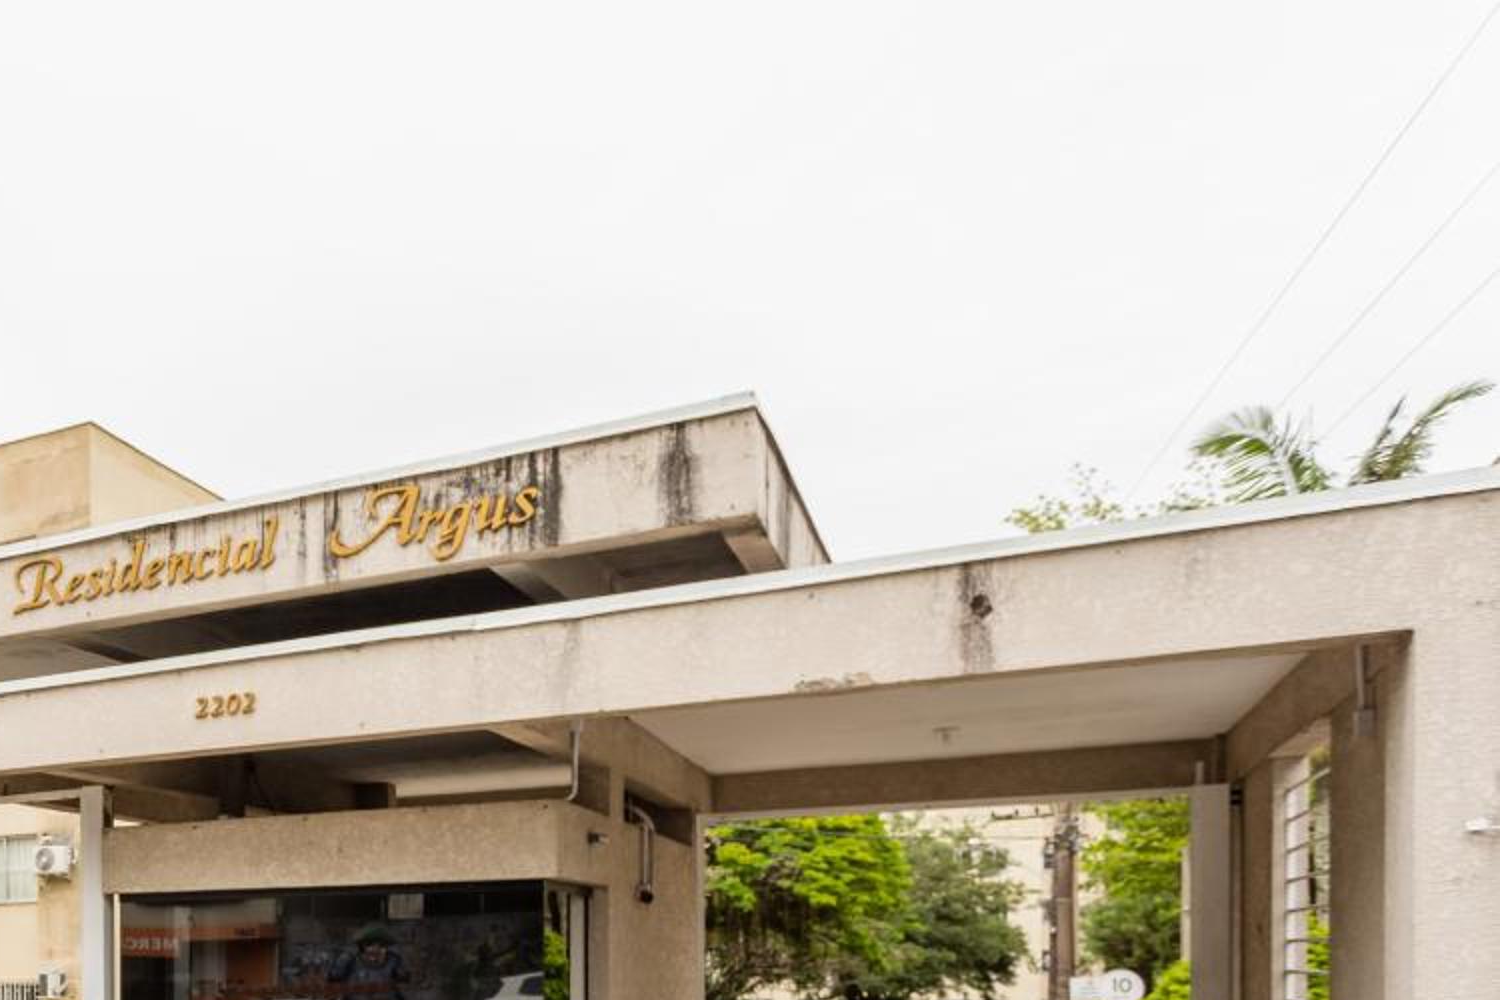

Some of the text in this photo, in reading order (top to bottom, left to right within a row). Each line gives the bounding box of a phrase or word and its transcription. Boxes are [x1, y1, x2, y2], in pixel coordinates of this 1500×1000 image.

[13, 484, 540, 616] Residencial Argus
[195, 692, 257, 719] 2202
[1112, 977, 1133, 993] 10
